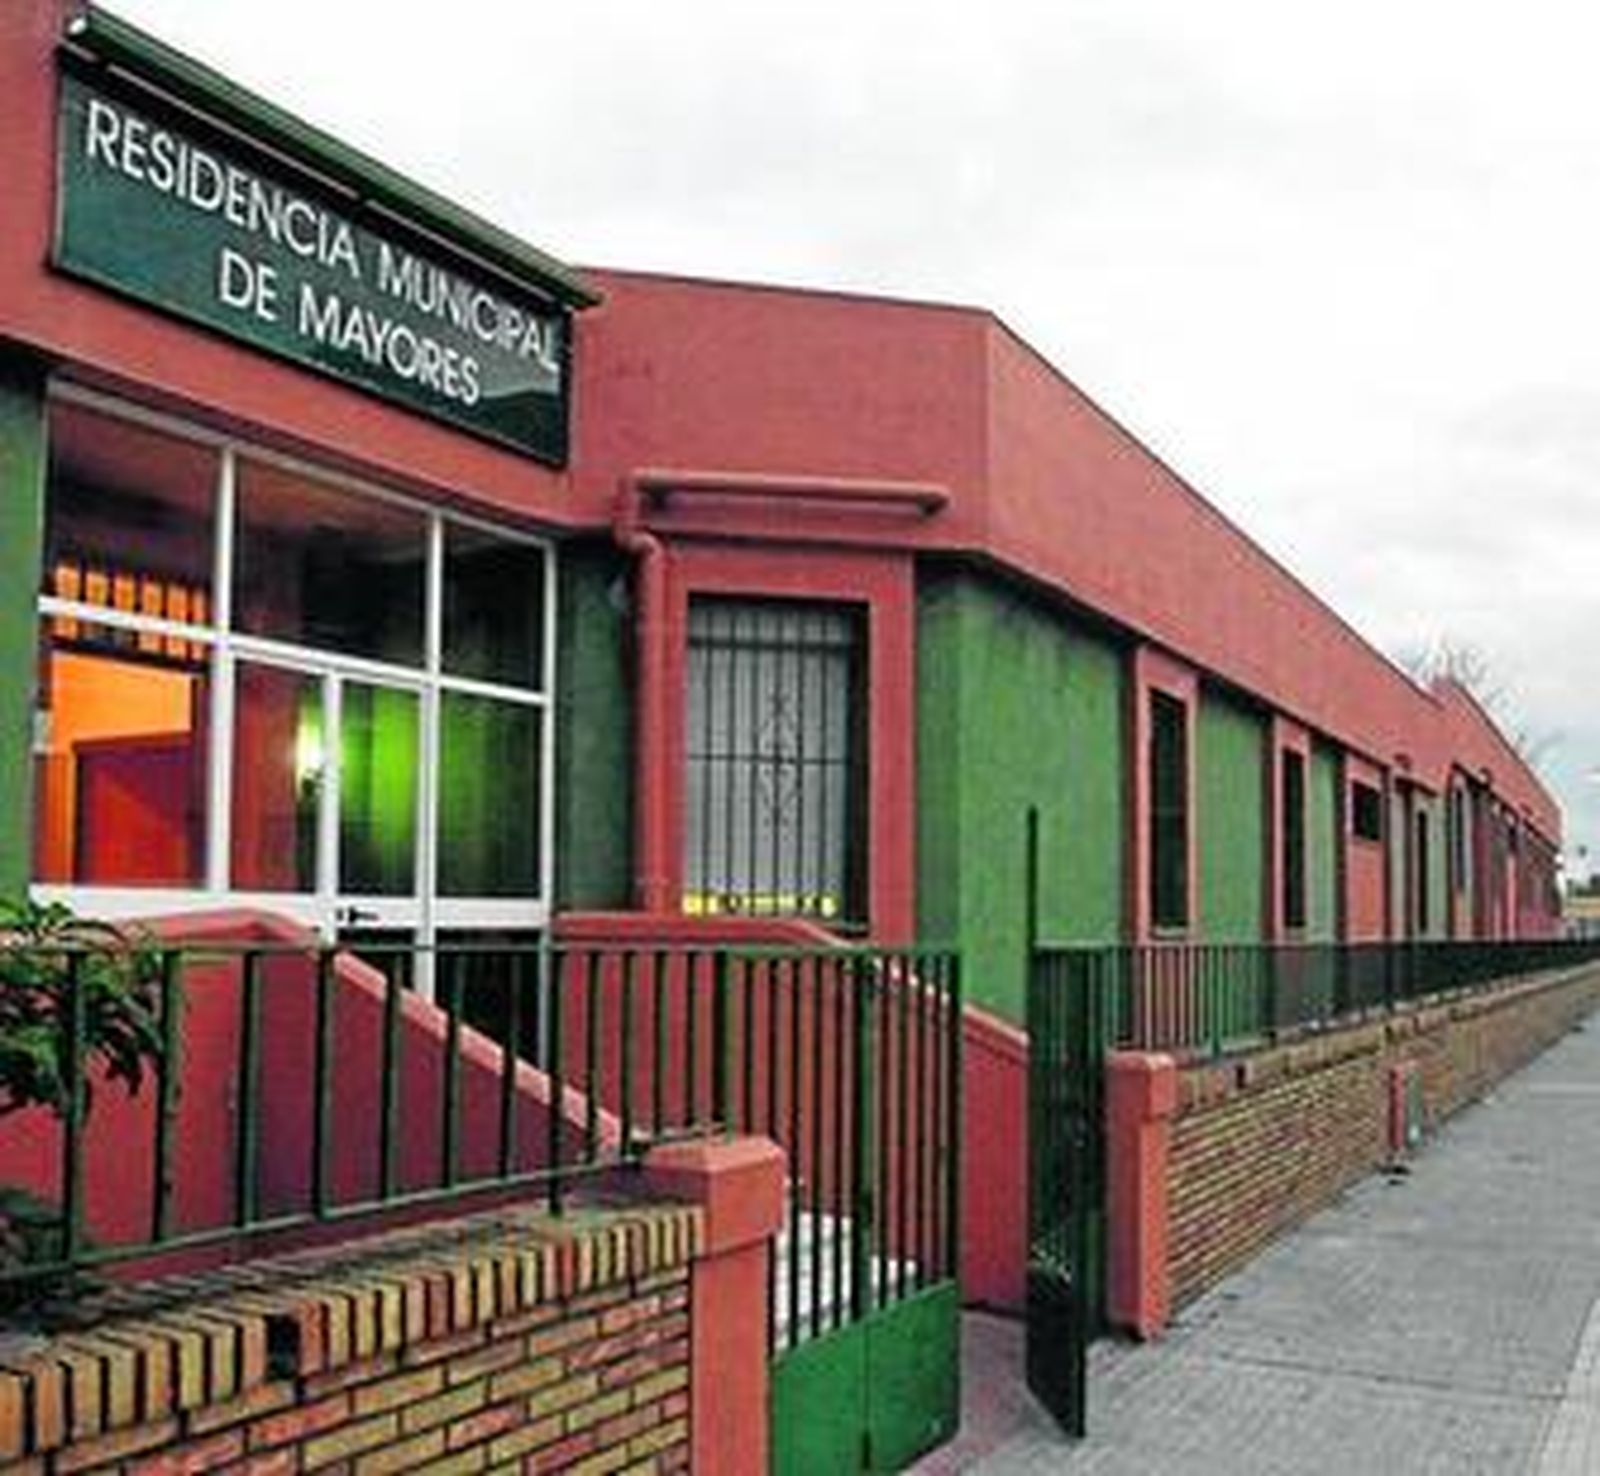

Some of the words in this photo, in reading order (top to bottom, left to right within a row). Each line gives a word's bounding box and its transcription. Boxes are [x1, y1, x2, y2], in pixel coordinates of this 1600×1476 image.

[86, 99, 360, 278] RESIDENCIA
[379, 243, 559, 371] MUNICIPAL
[219, 248, 278, 322] DE
[299, 285, 480, 404] MAYORES
